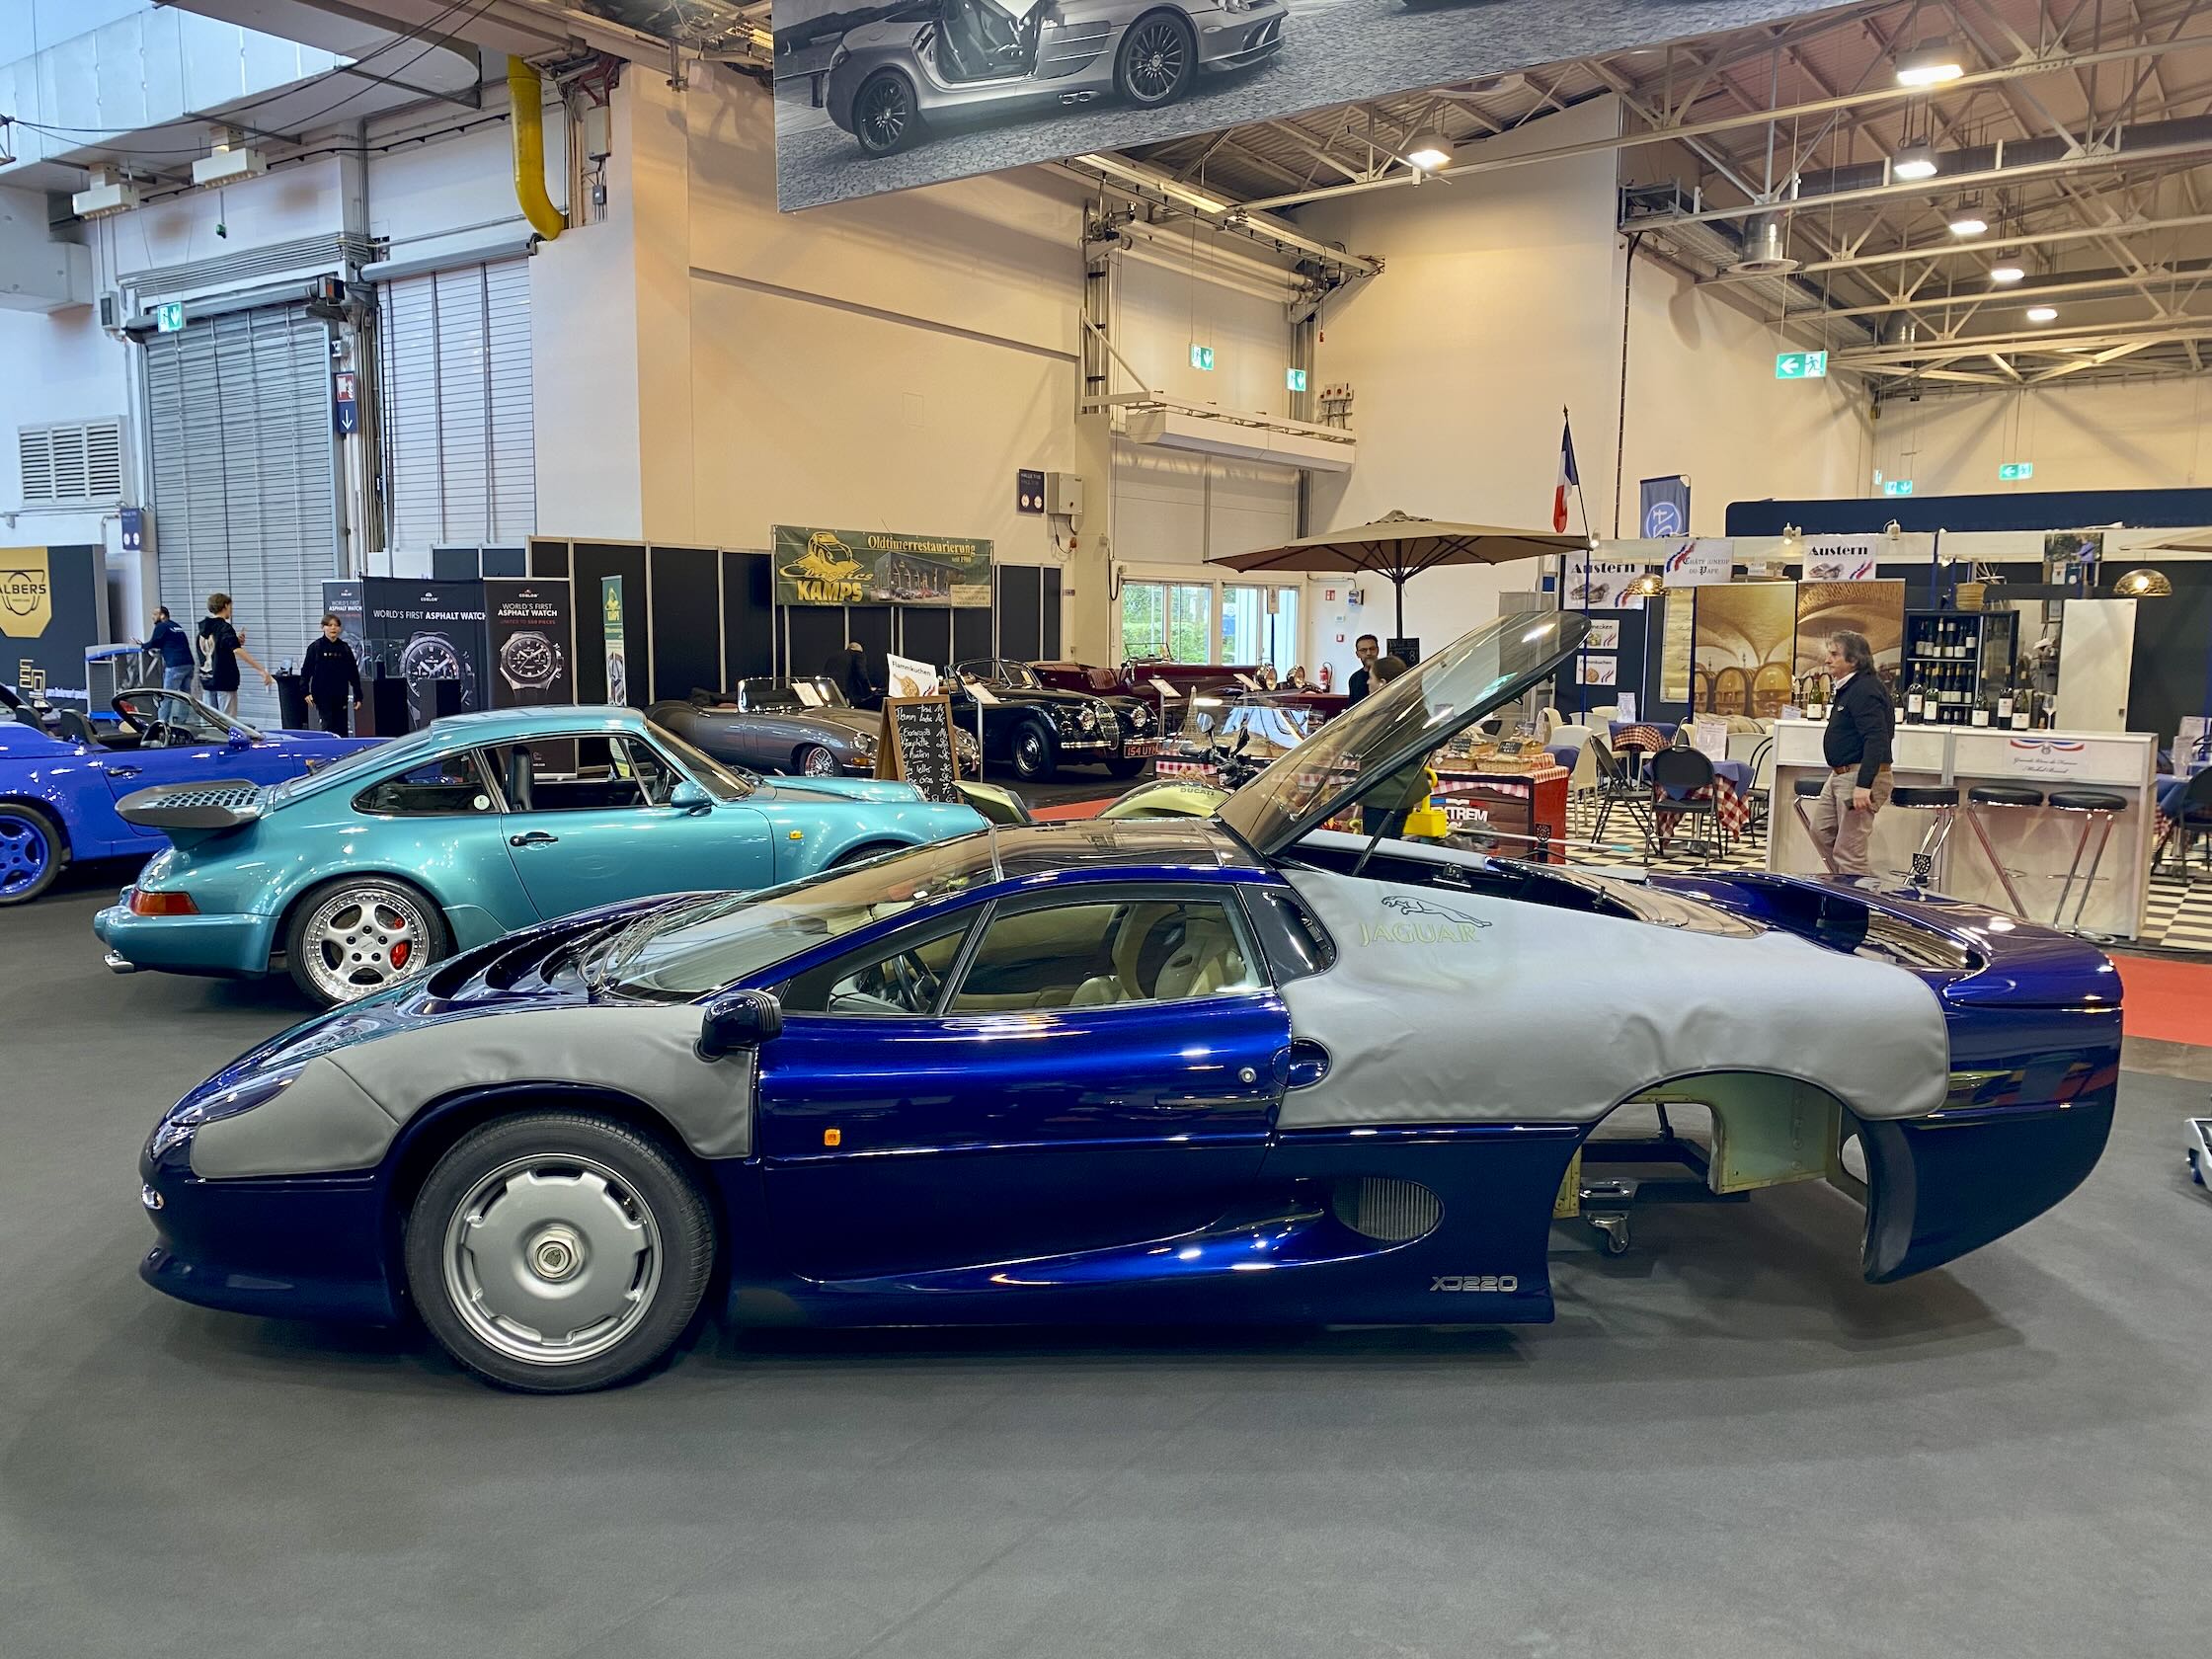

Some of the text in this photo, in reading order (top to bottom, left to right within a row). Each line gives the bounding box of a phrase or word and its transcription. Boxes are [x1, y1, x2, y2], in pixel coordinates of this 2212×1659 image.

[867, 535, 976, 557] Oldtimerrestaurierung
[1808, 546, 1867, 556] Austern
[779, 564, 874, 581] Classics
[1571, 563, 1635, 574] Austern
[797, 580, 863, 602] KAMPS
[373, 609, 404, 619] WORLD'S
[425, 611, 458, 620] ASPHALT
[892, 661, 931, 676] Flammkuchen
[1127, 747, 1141, 756] 154
[1180, 787, 1215, 797] DUCATI
[1358, 921, 1480, 948] JAGUAR
[1430, 1275, 1518, 1293] XJ220
